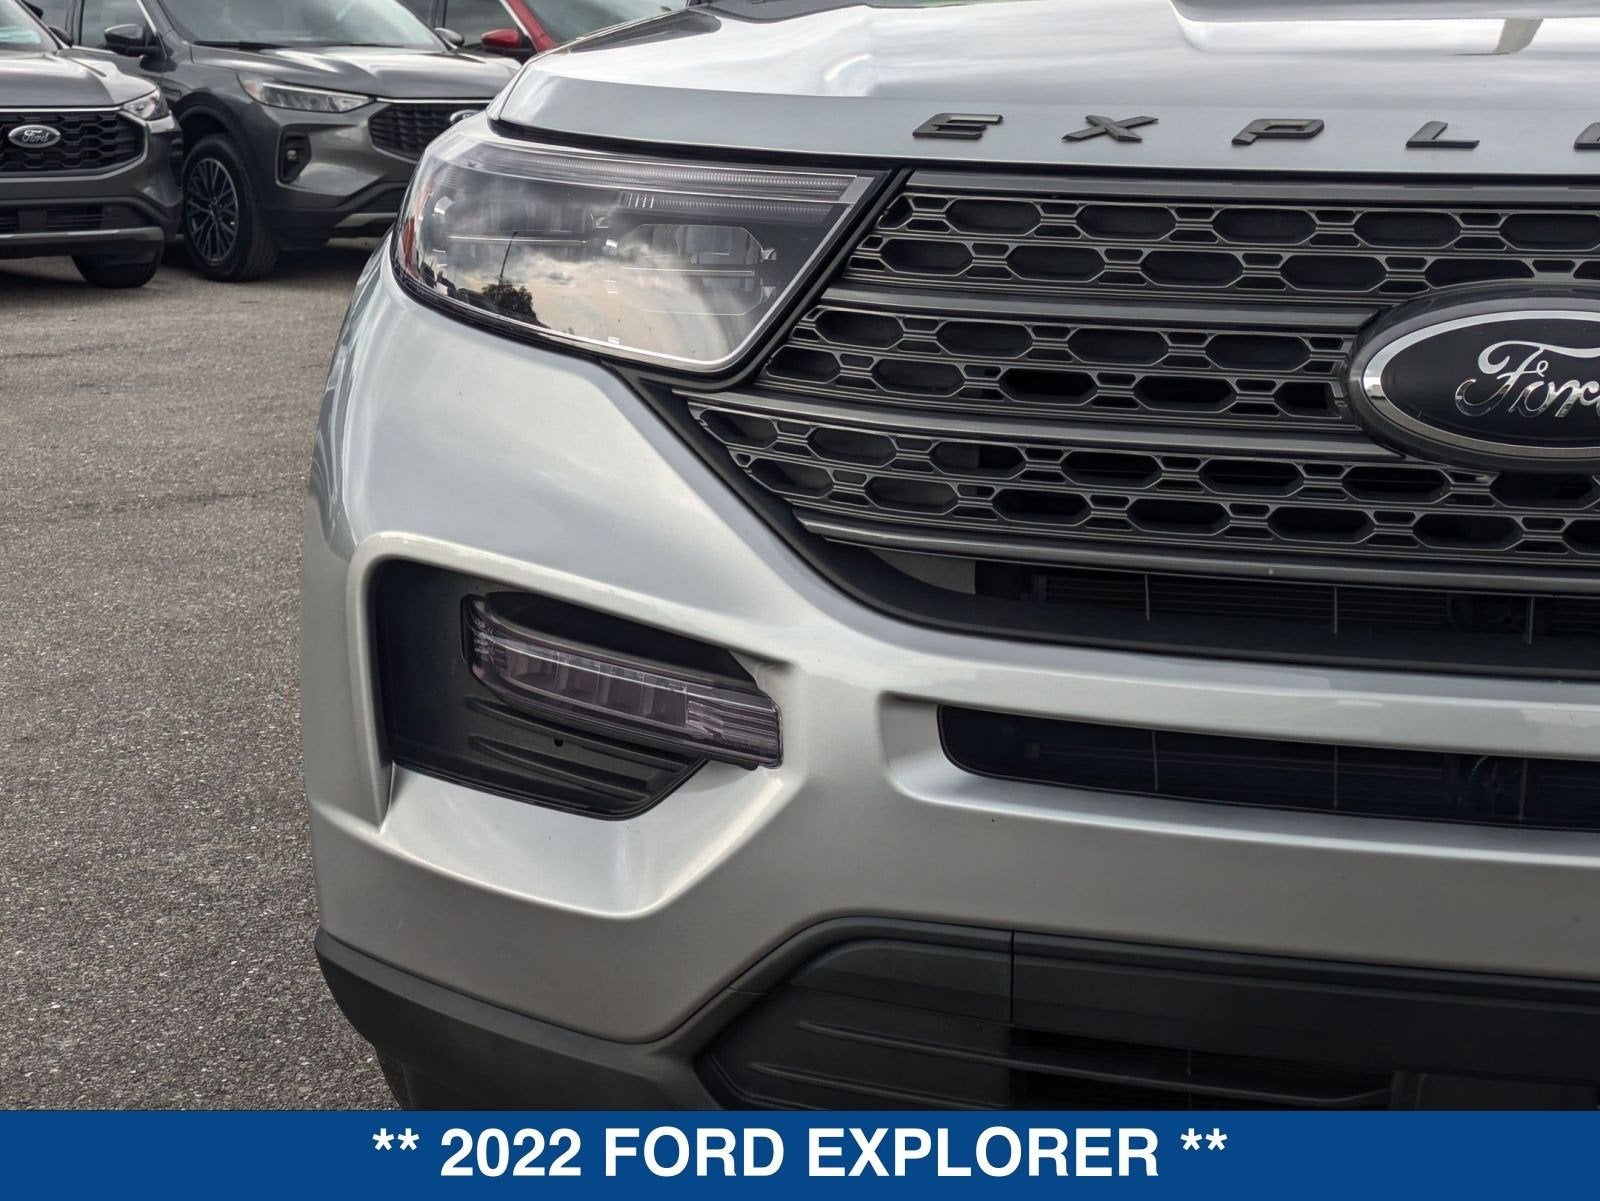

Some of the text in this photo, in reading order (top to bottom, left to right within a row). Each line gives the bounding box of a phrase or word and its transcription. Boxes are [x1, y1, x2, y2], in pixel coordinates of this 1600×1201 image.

[22, 129, 50, 143] Ford
[912, 111, 1600, 152] EXPL
[1454, 340, 1600, 418] For
